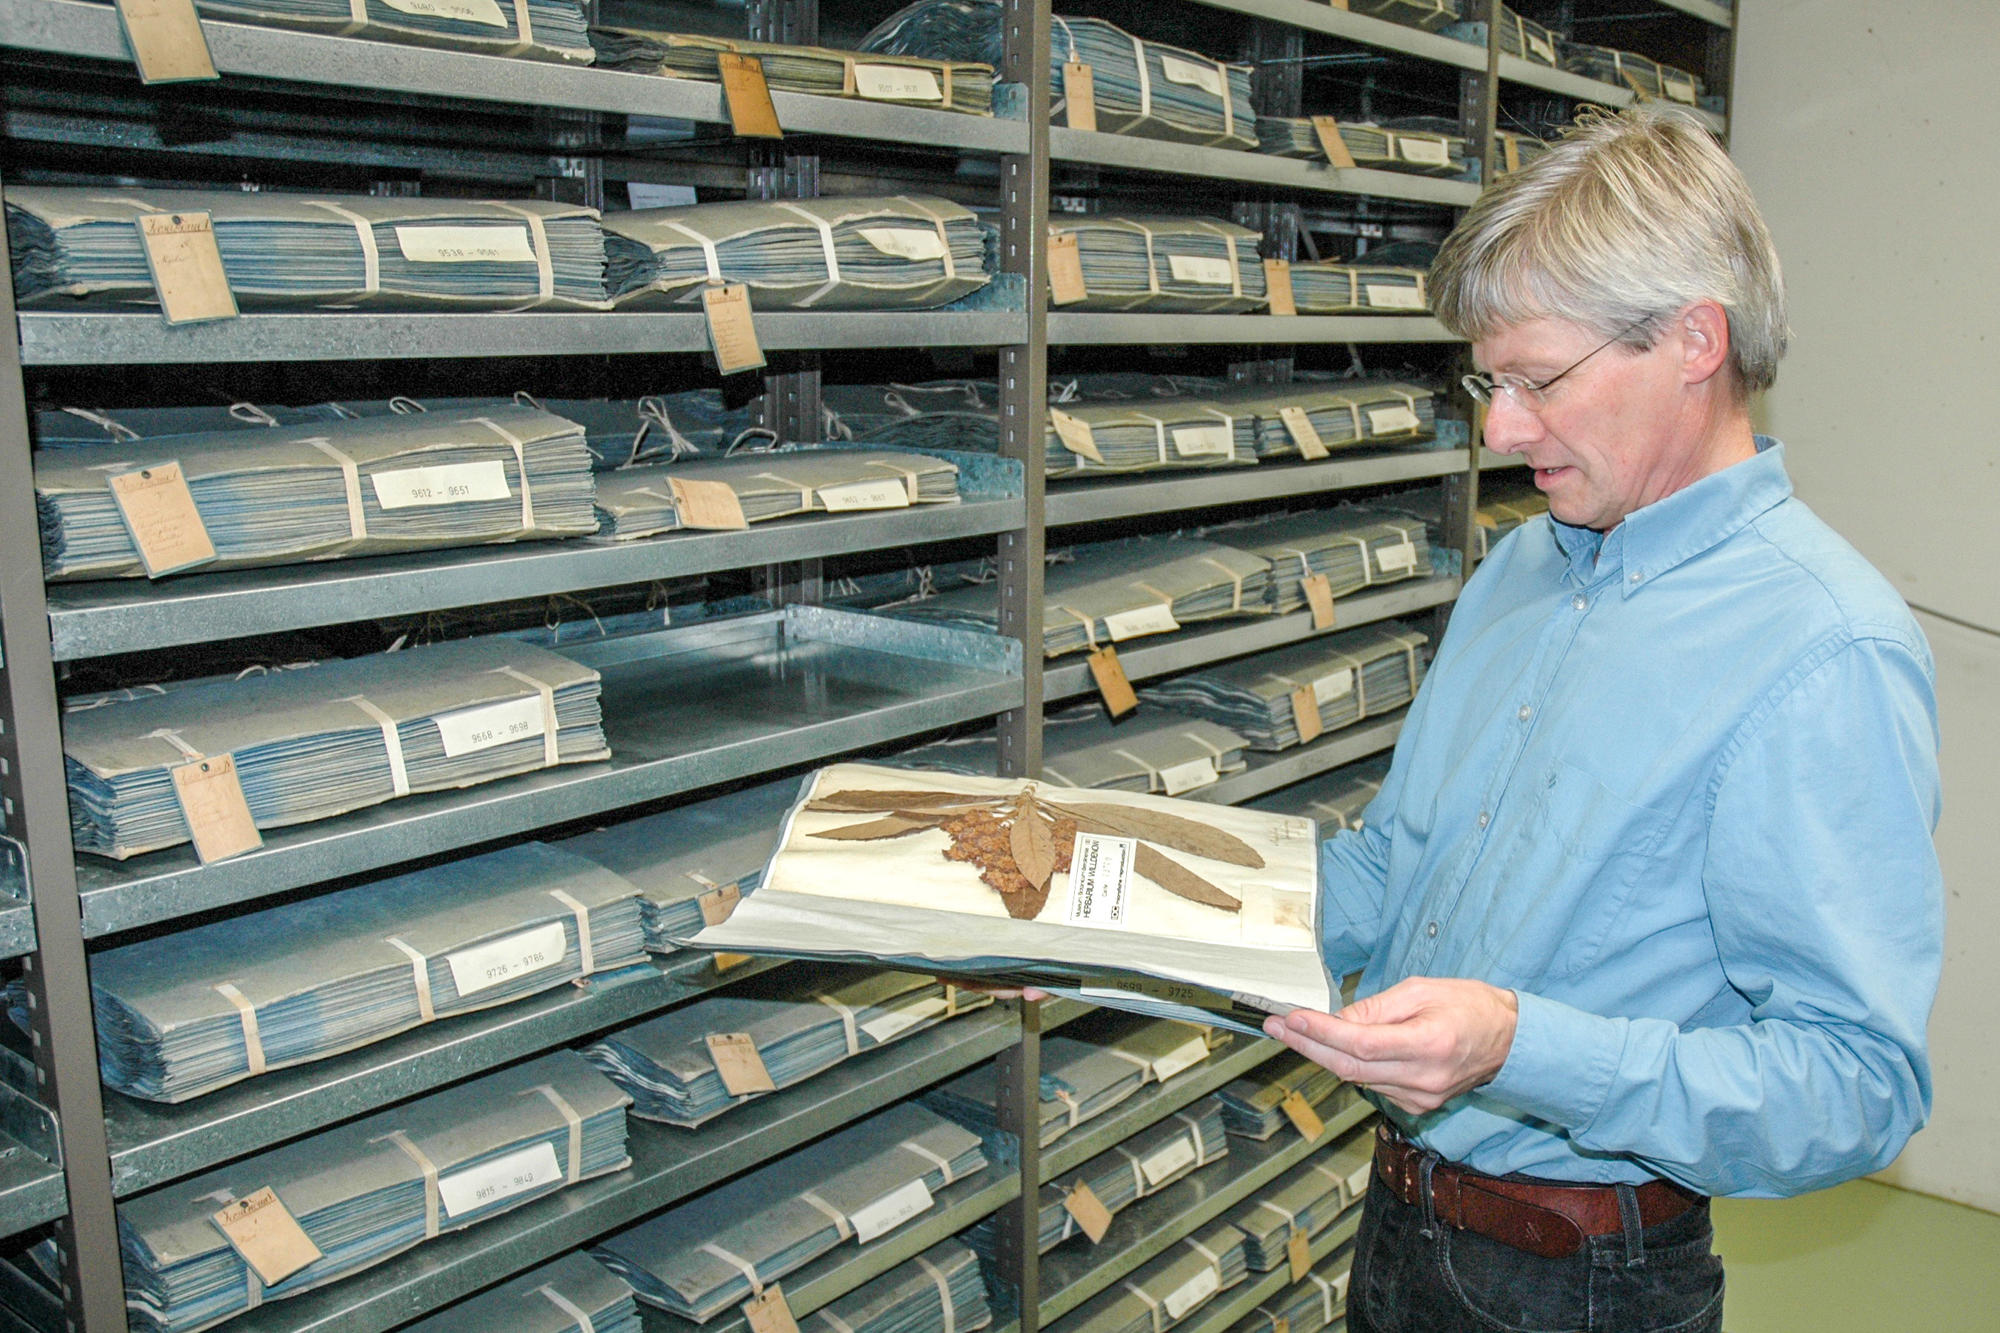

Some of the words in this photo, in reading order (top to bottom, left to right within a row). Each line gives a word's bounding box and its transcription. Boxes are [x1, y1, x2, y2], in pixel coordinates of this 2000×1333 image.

[411, 488, 433, 498] 9612
[448, 485, 470, 496] 9651
[471, 729, 494, 744] 9668
[508, 721, 529, 734] 9698
[1088, 839, 1100, 877] WILLDENOW
[1083, 879, 1095, 918] HERBARIUM
[486, 964, 508, 979] 9726
[523, 952, 545, 966] 9786
[1168, 986, 1194, 999] 9725
[476, 1185, 495, 1200] 9815
